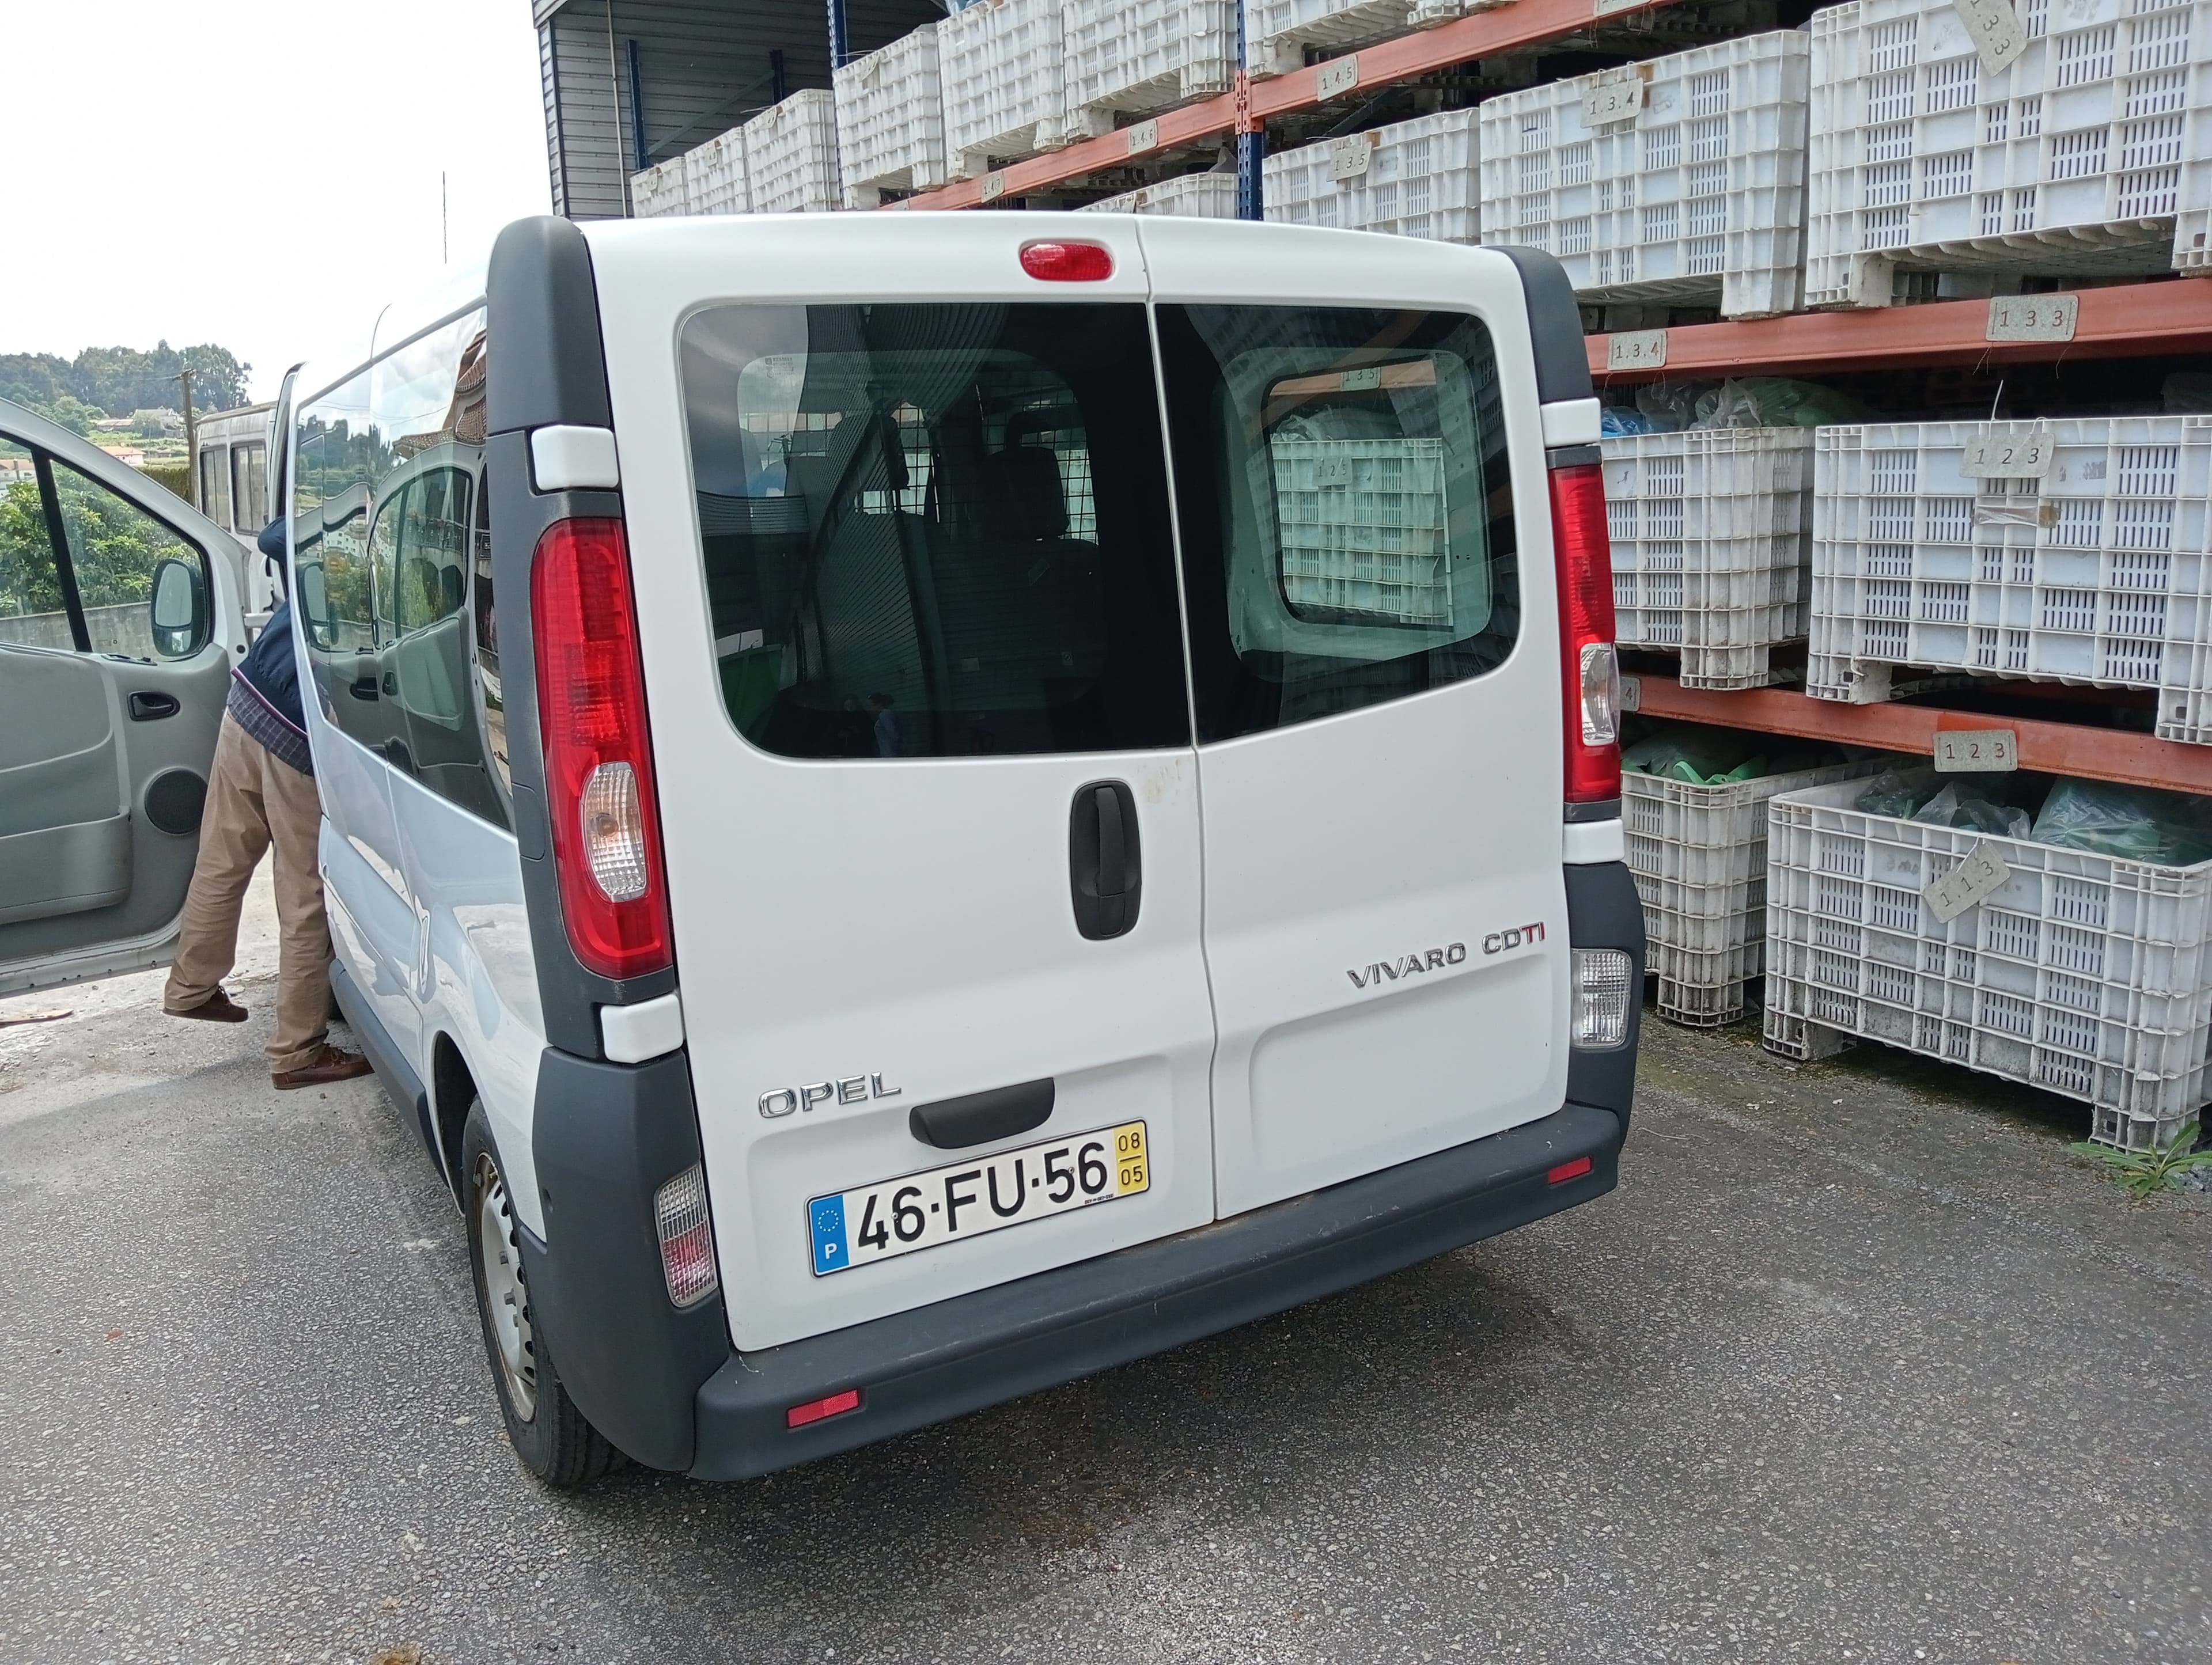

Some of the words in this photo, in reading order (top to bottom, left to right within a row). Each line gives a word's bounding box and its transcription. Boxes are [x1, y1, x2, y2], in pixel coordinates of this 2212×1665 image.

[1346, 942, 1466, 989] VIVARO
[758, 1071, 902, 1118] OPEL
[1118, 1132, 1140, 1151] 08
[1121, 1165, 1143, 1186] 05
[824, 1243, 837, 1260] P
